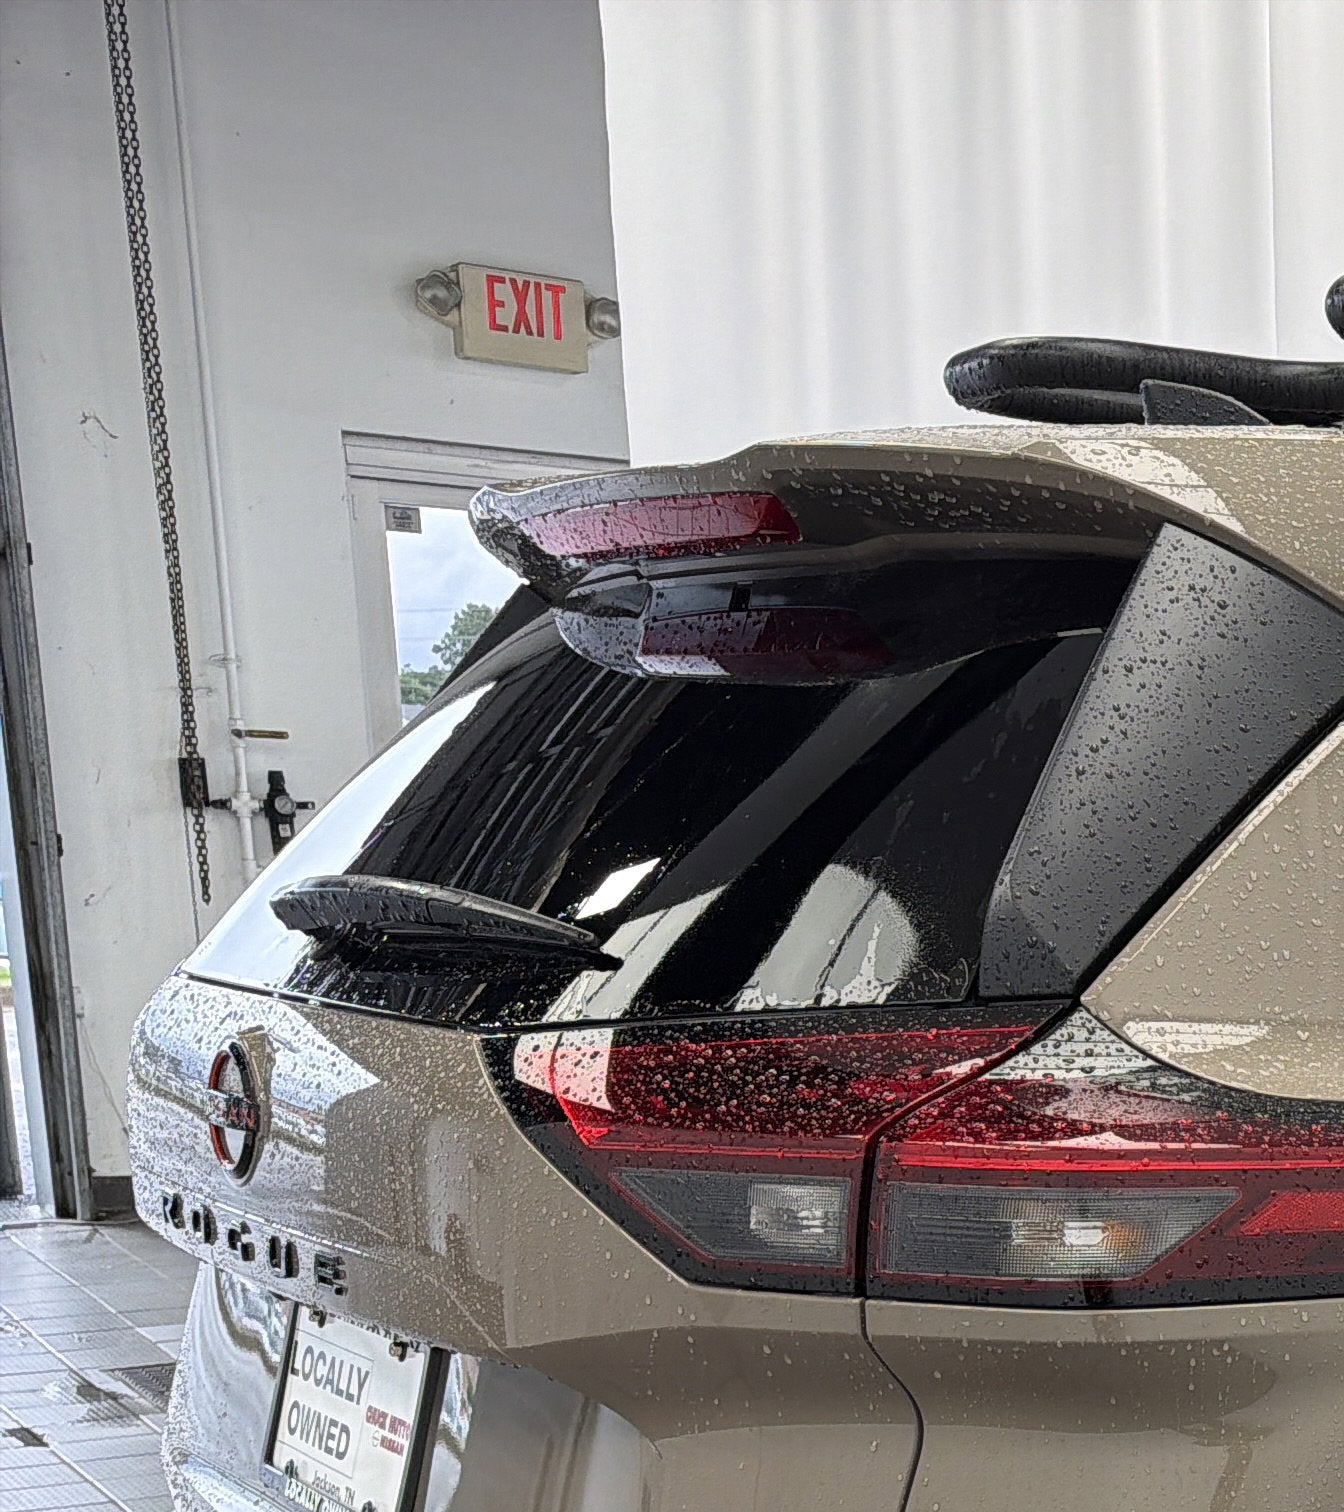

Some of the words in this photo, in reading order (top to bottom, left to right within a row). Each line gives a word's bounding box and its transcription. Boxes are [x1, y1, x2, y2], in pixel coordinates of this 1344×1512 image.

[485, 273, 567, 341] EXIT
[162, 1192, 348, 1297] ROGUE
[290, 1339, 370, 1406] LOCALLY
[287, 1399, 351, 1461] OWNED
